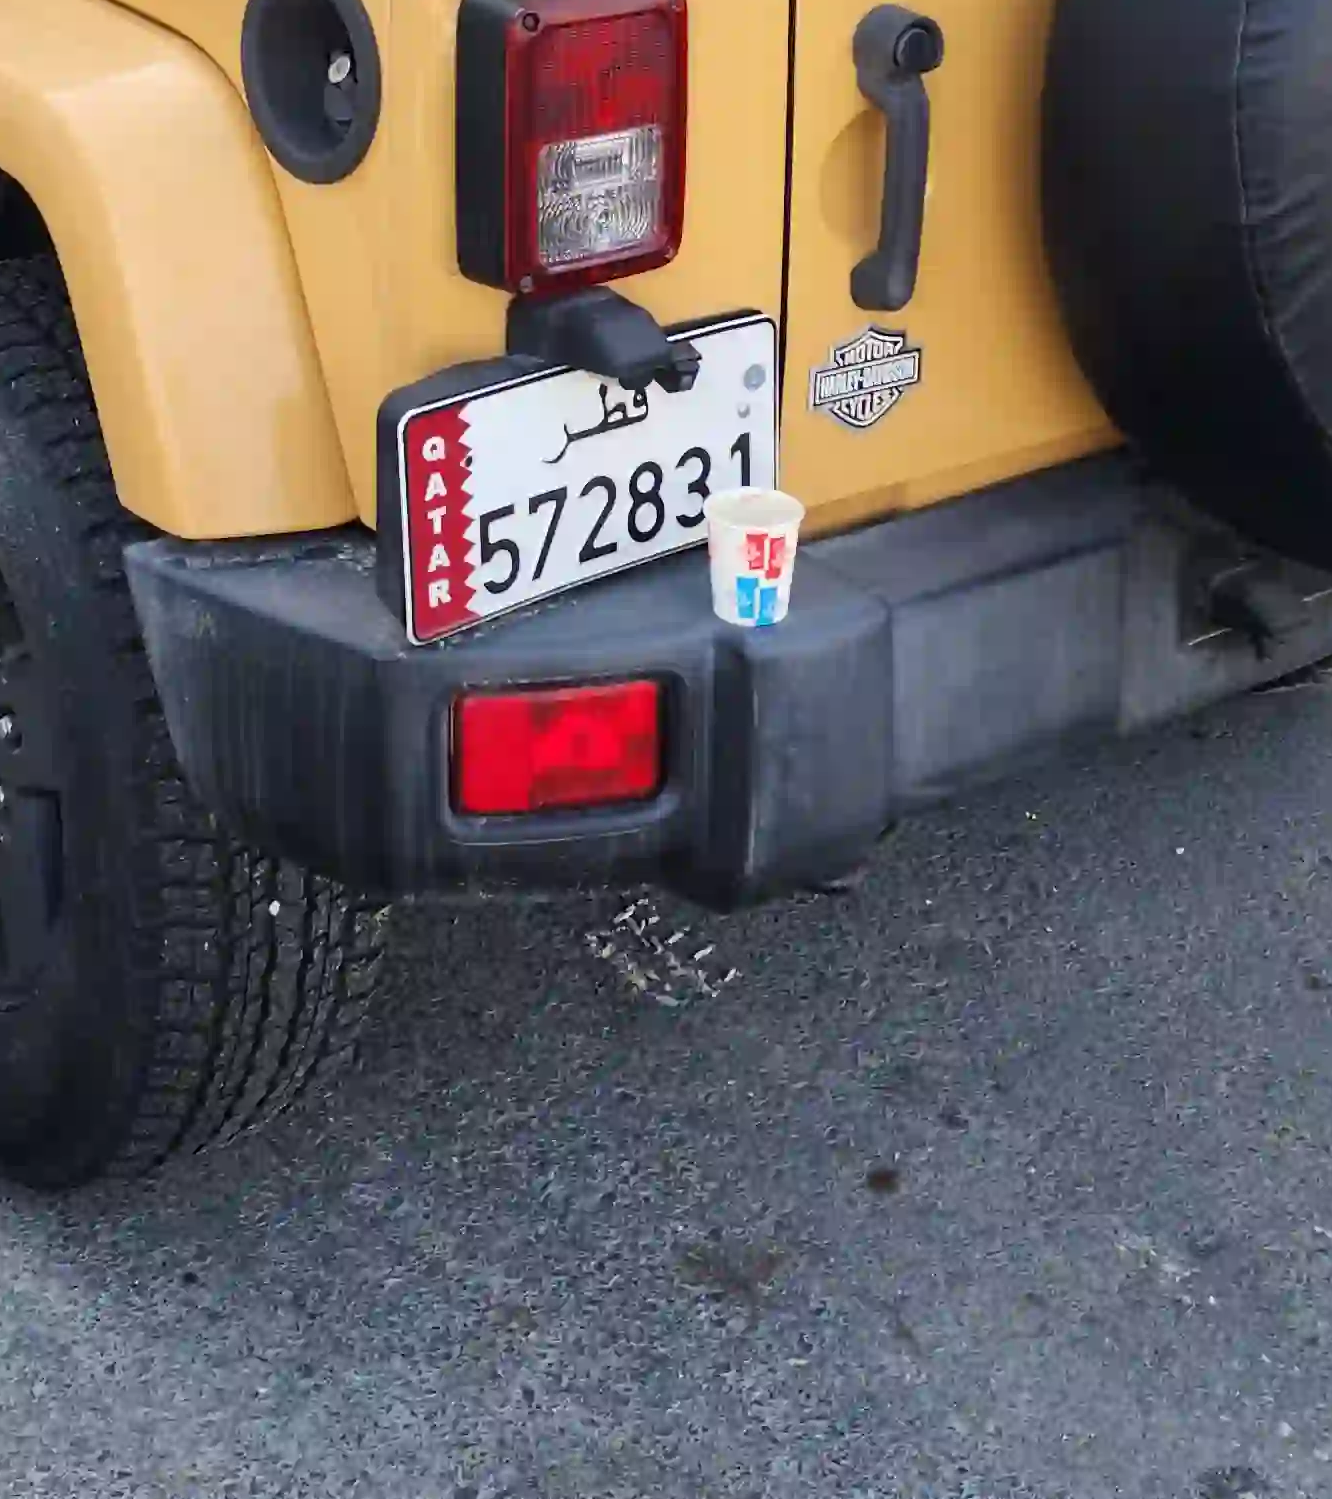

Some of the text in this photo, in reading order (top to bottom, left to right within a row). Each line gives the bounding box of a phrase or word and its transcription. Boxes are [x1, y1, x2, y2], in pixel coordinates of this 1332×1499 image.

[844, 341, 896, 365] MOTOR
[542, 385, 649, 464] قطر
[420, 434, 452, 608] QATAR
[479, 431, 753, 595] 572831
